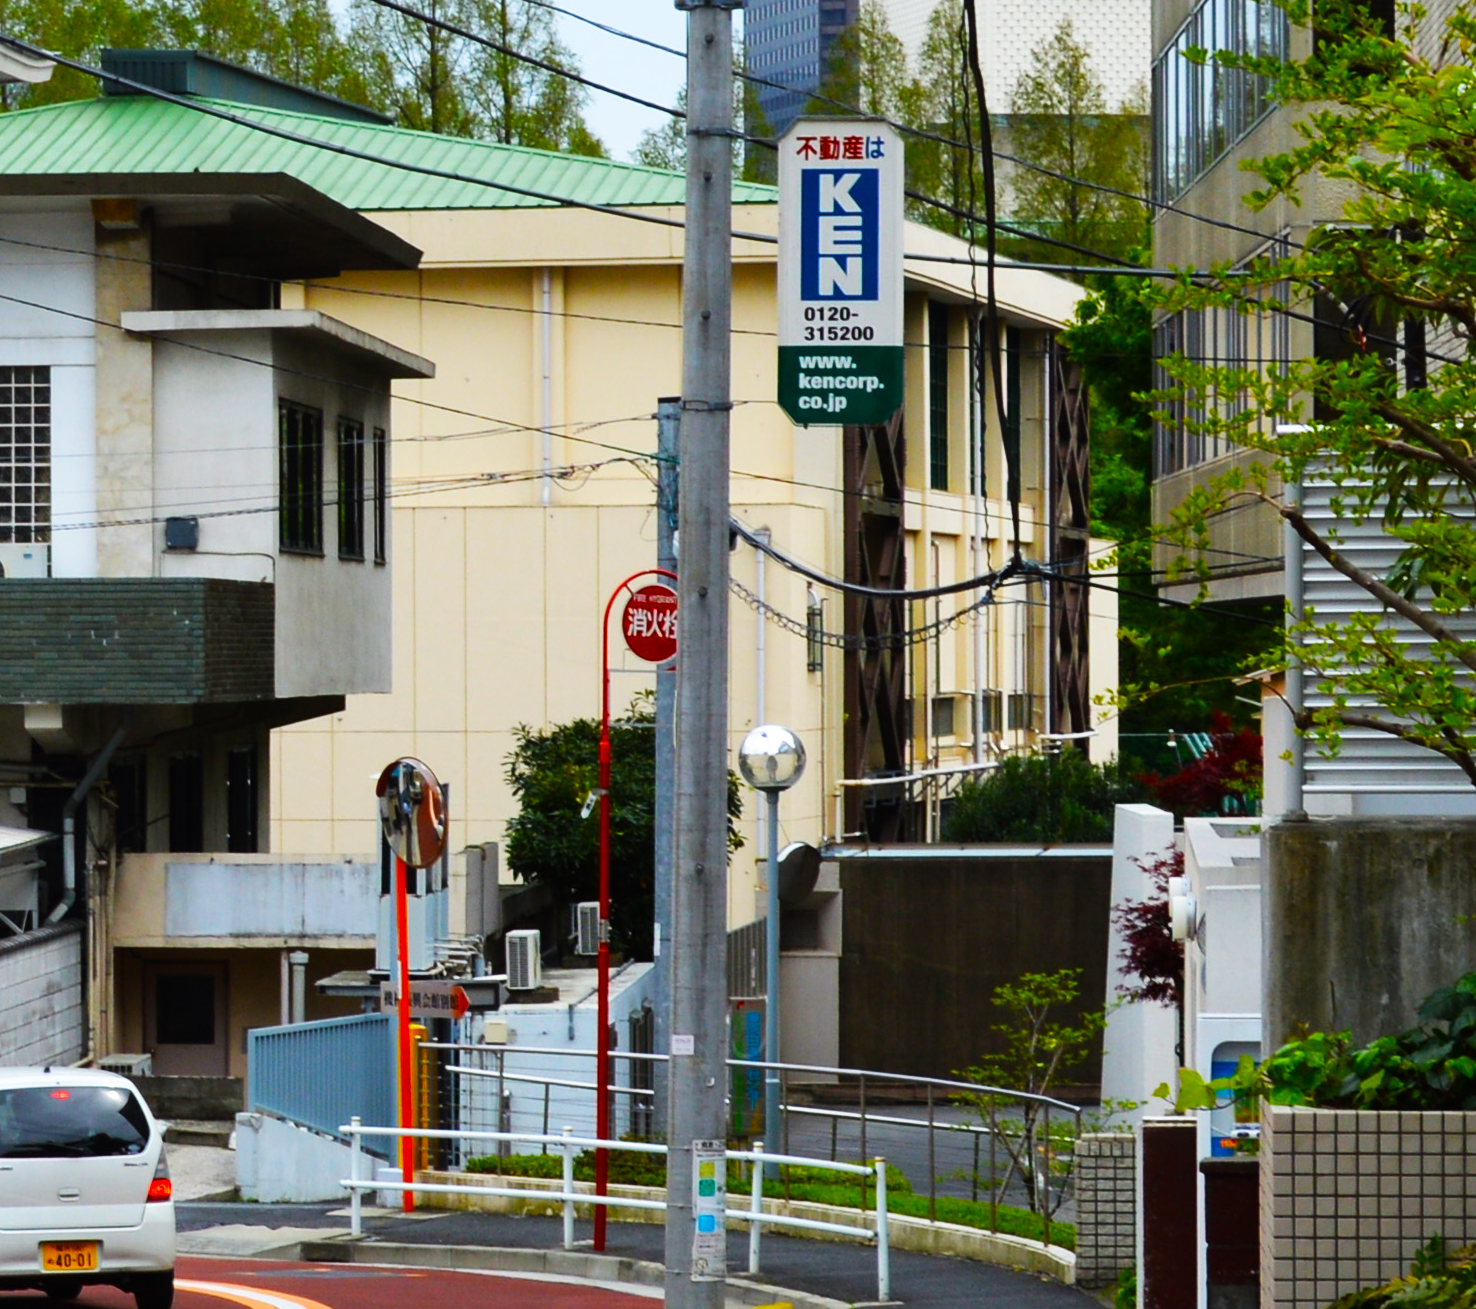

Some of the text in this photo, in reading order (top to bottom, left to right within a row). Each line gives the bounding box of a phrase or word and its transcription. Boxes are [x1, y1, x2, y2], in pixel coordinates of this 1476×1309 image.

[796, 136, 885, 160] 不動産は
[818, 173, 863, 296] KEN
[804, 307, 859, 321] 0120-
[804, 326, 874, 341] 315200
[798, 356, 857, 369] www.
[798, 373, 885, 392] kencorp.
[798, 393, 847, 412] co.jp
